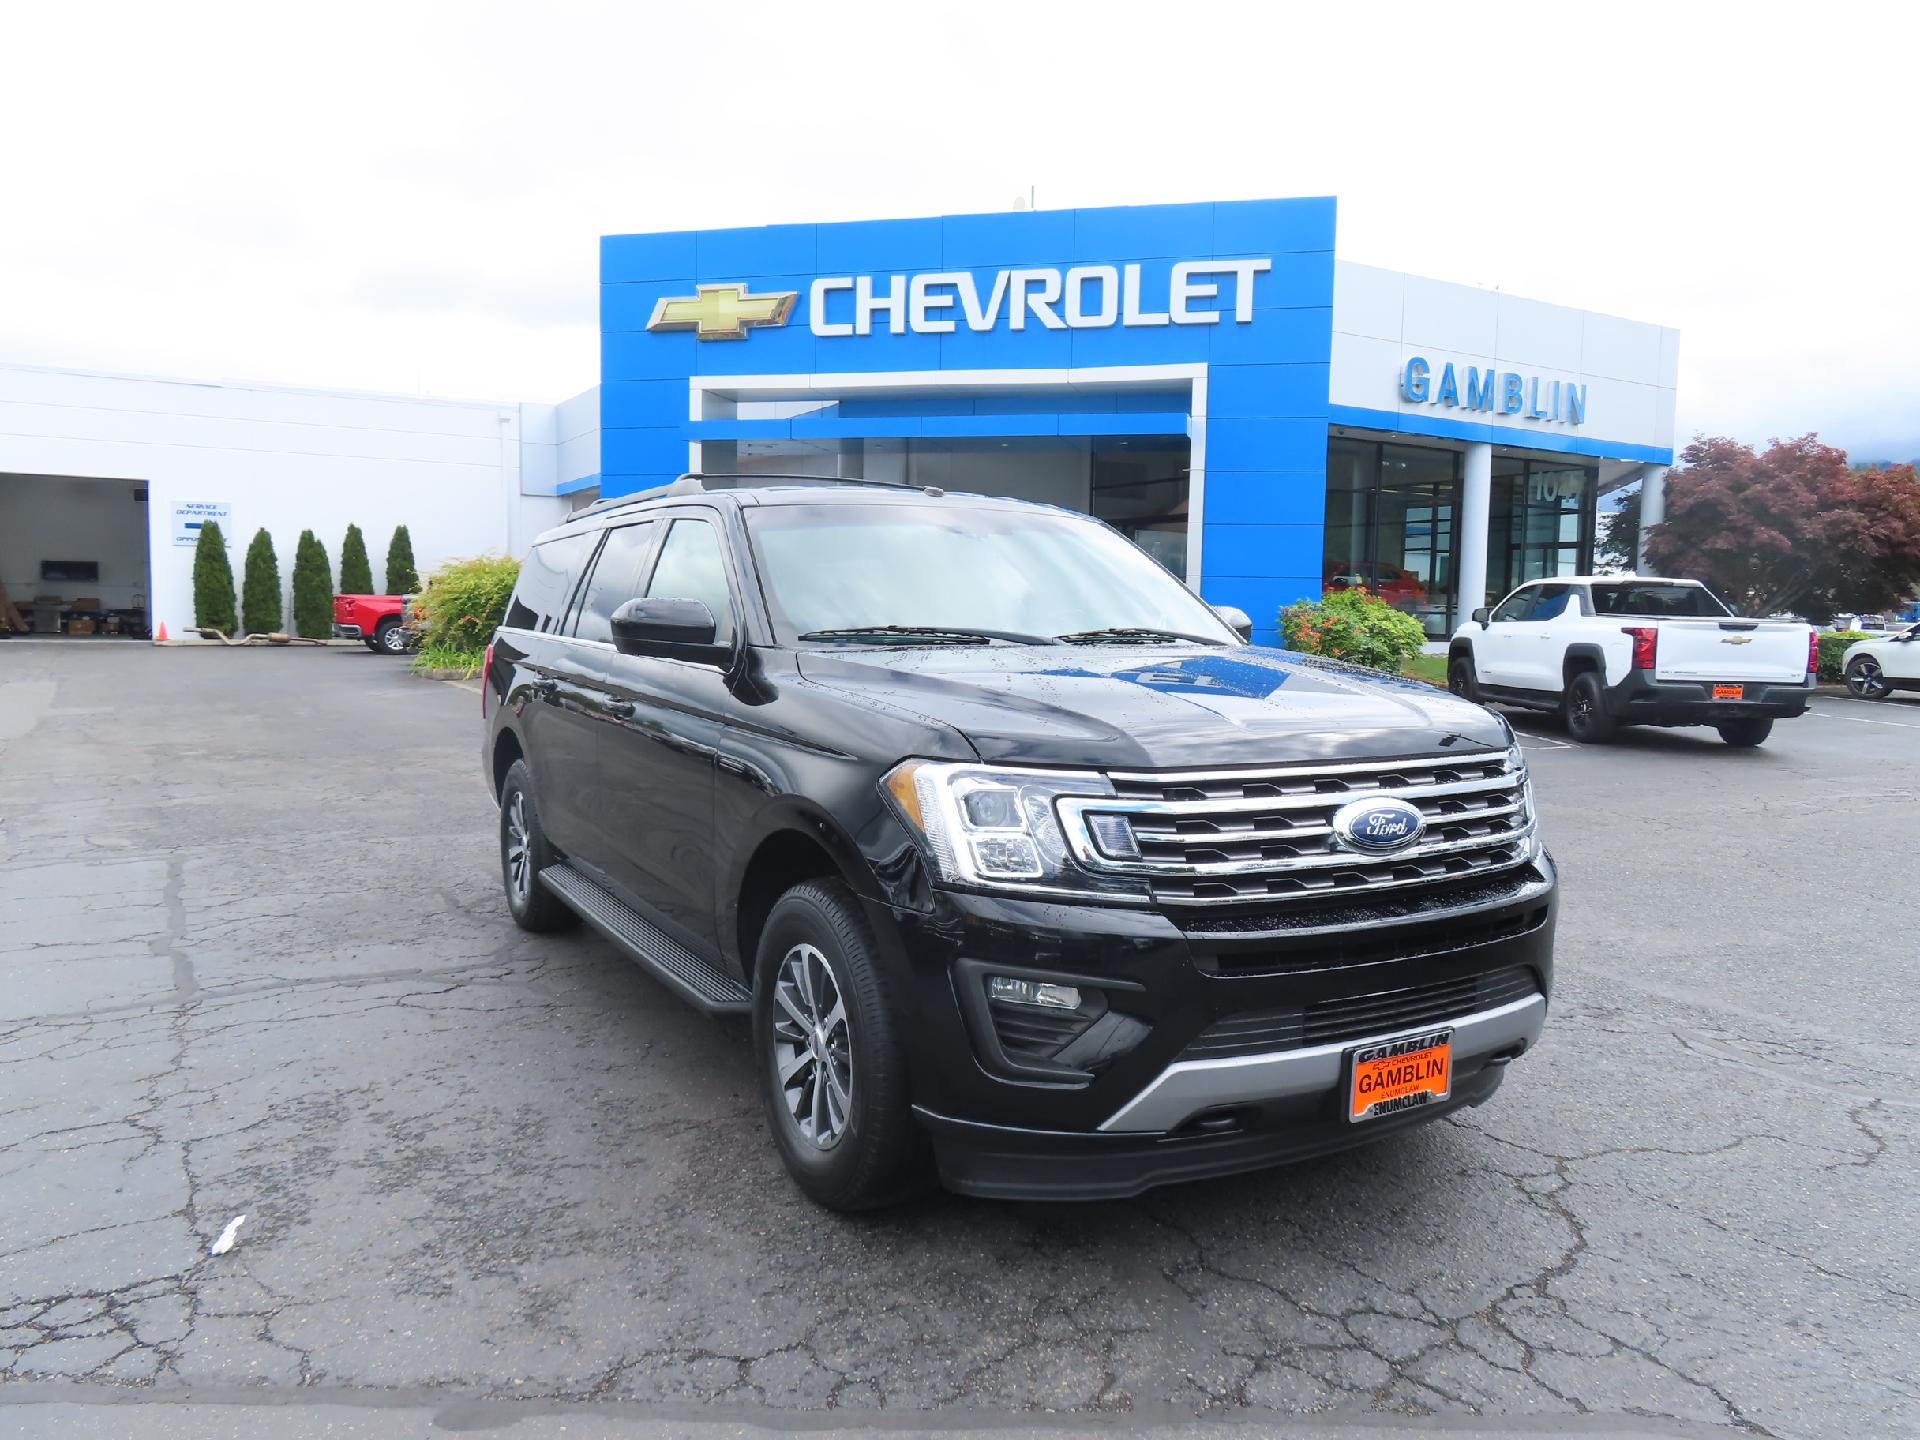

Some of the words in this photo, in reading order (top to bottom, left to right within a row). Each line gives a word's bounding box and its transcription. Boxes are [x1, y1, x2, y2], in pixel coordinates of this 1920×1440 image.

[809, 258, 1272, 337] CHEVROLET
[1400, 356, 1587, 425] GAMBLIN
[1366, 813, 1408, 836] Ford
[1358, 1032, 1450, 1063] GAMBLIN
[1391, 1051, 1433, 1067] CHEVROLET
[1358, 1058, 1444, 1094] GAMBLIN
[1373, 1090, 1428, 1116] ENUMCLAW
